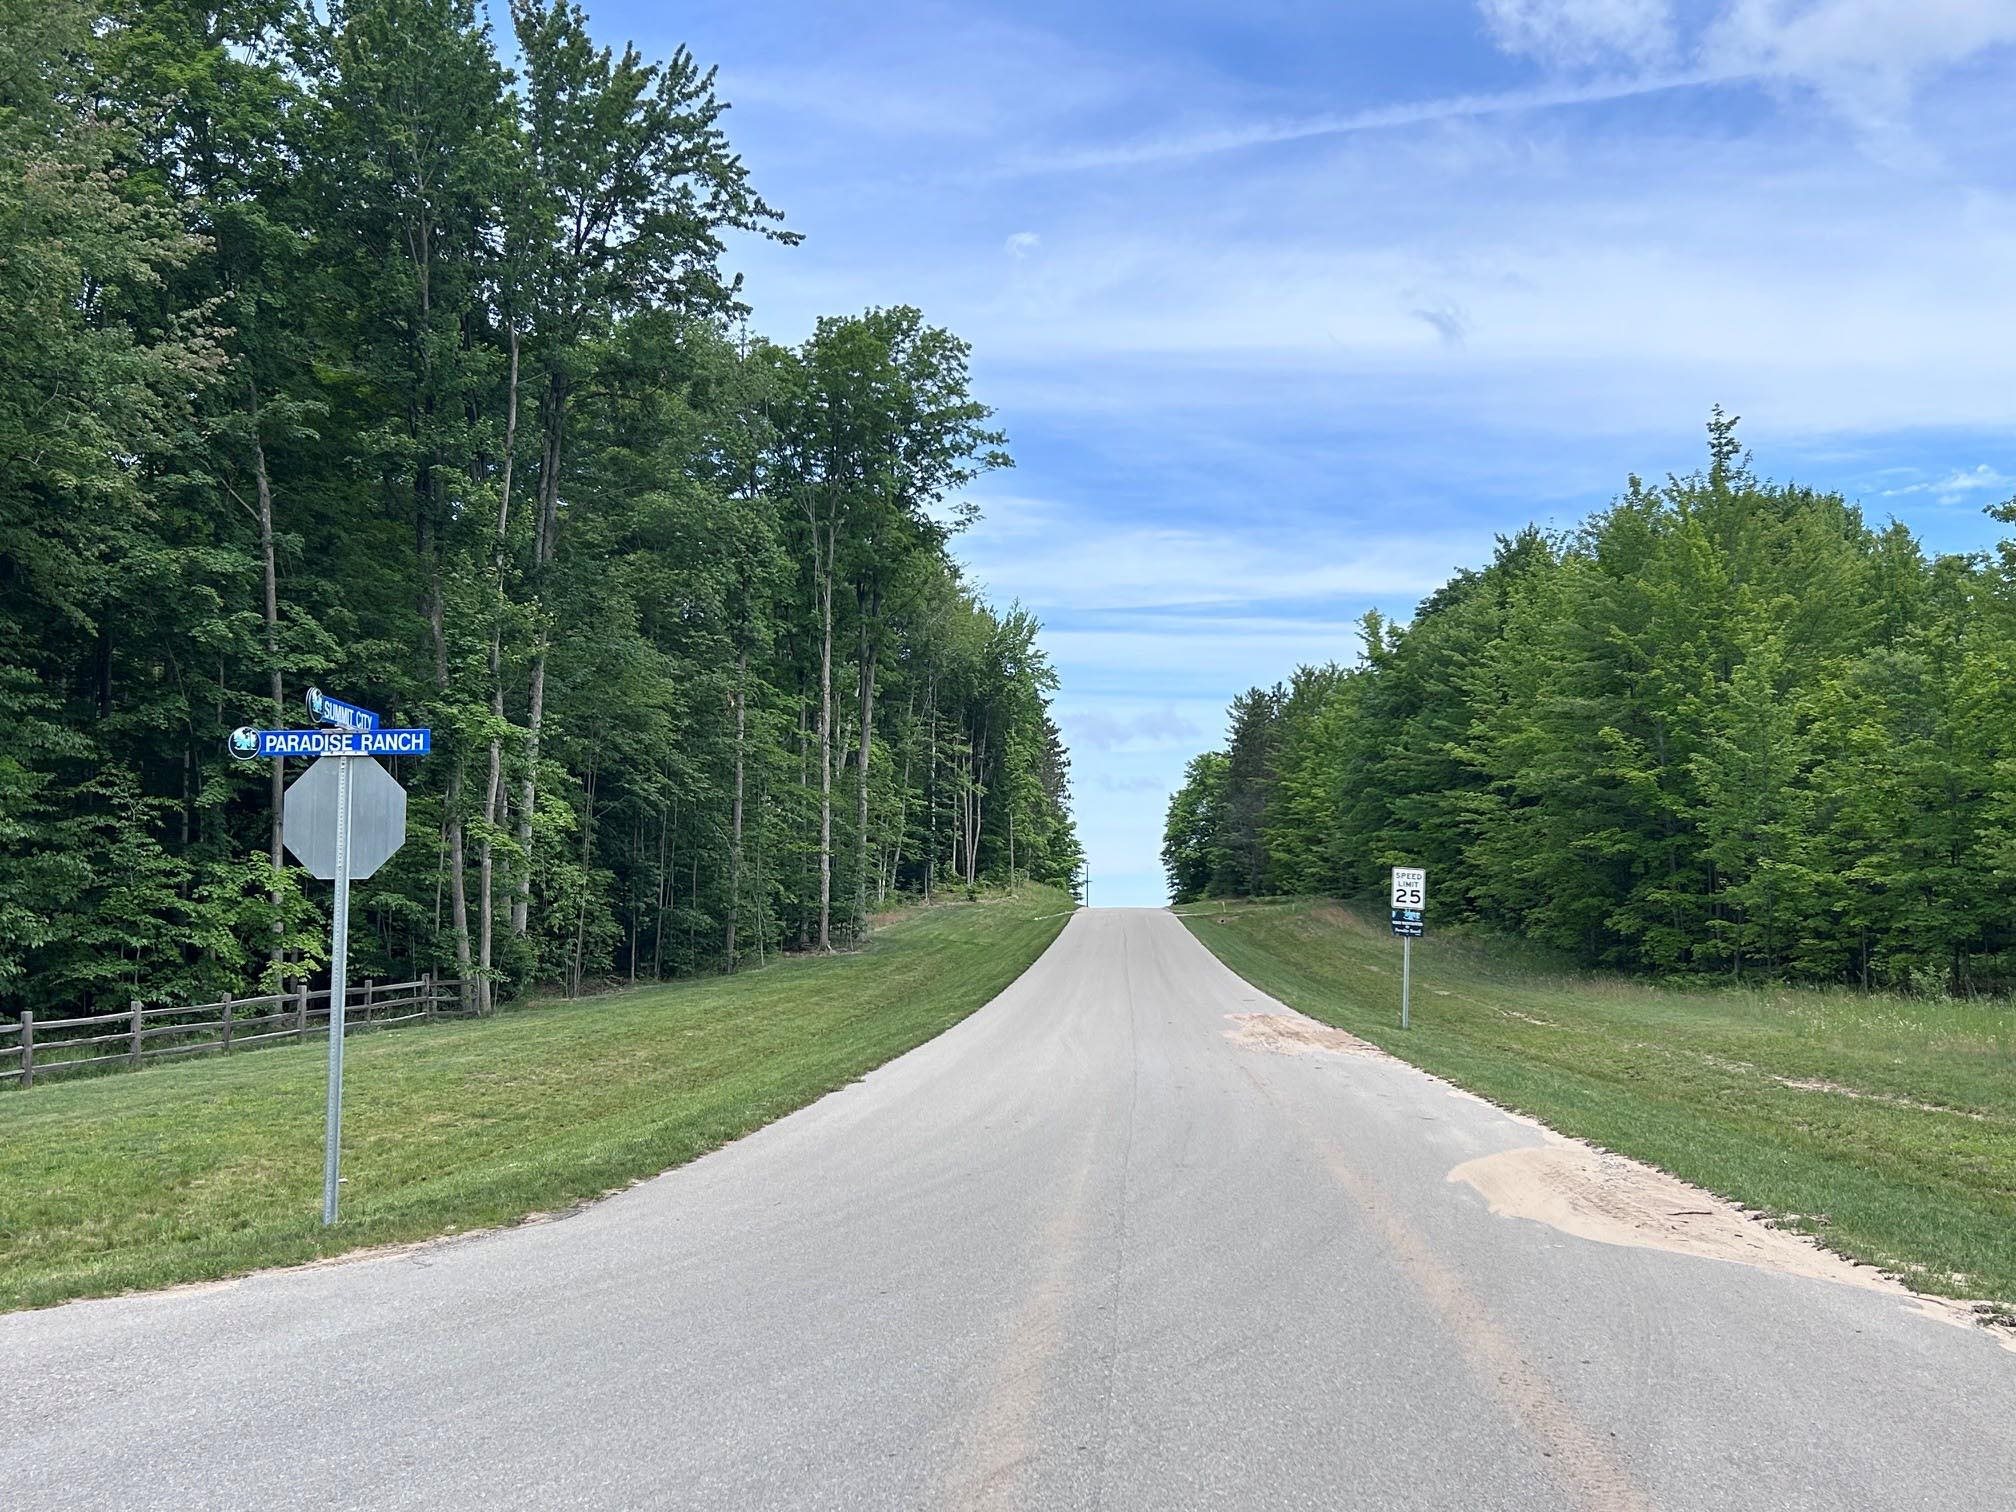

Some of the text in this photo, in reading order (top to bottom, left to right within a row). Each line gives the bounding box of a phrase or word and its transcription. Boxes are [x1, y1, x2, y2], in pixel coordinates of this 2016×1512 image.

[324, 702, 373, 731] SUMMIT CITY
[266, 733, 424, 752] PARADISE RANCH
[1396, 889, 1421, 904] 25
